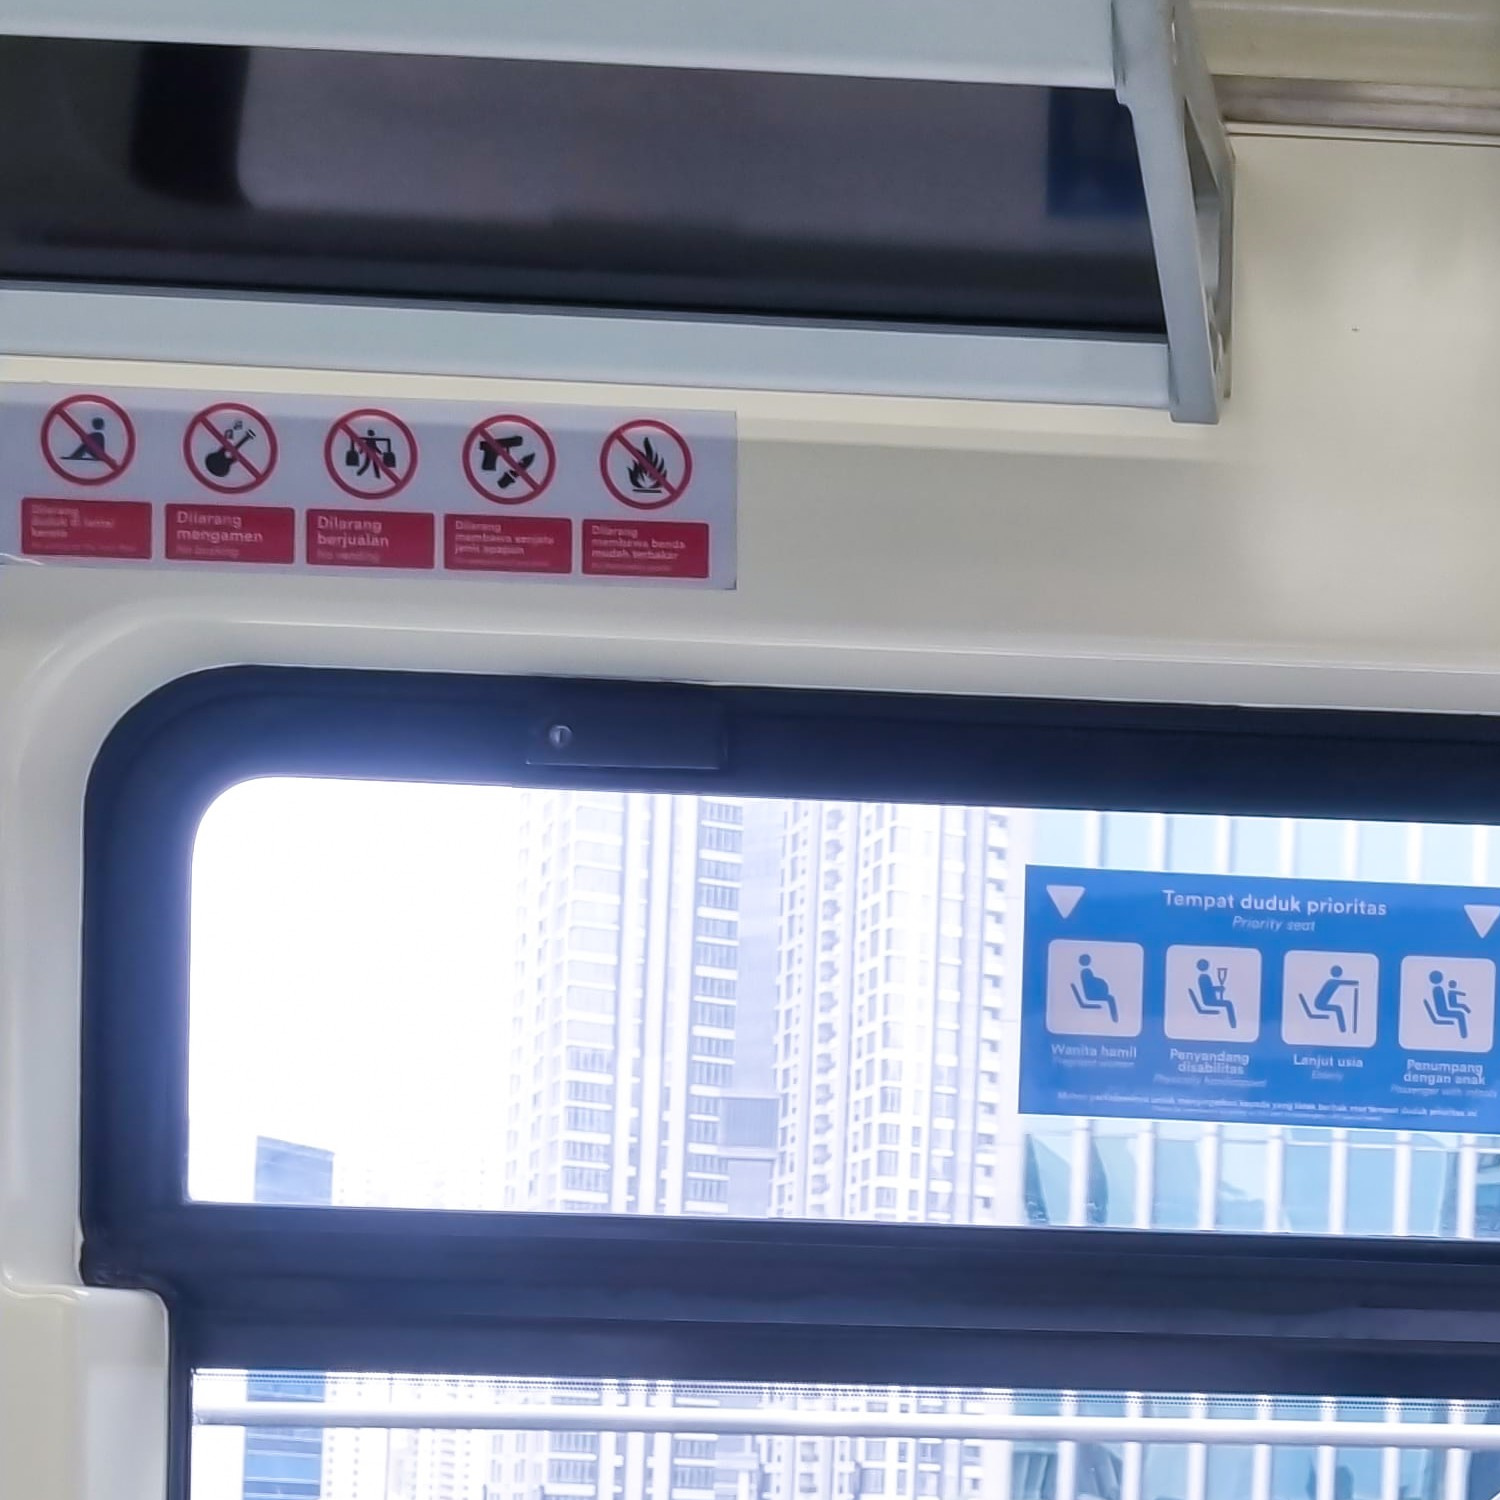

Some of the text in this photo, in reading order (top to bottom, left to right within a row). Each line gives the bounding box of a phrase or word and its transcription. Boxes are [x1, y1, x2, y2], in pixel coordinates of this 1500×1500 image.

[175, 510, 242, 529] Dilarang
[317, 515, 382, 535] Dilarang
[176, 528, 263, 545] mengamen
[317, 532, 389, 549] berjualan
[1162, 889, 1388, 916] Tempat duduk prioritas
[1231, 915, 1317, 932] Priority seat
[1051, 1043, 1137, 1058] Wanita hamil
[1170, 1048, 1250, 1066] Penyandang
[1177, 1060, 1244, 1075] disabilitas
[1293, 1053, 1364, 1069] Lanjut usia
[1406, 1058, 1484, 1075] Penumpang
[1403, 1072, 1486, 1085] dengan anak
